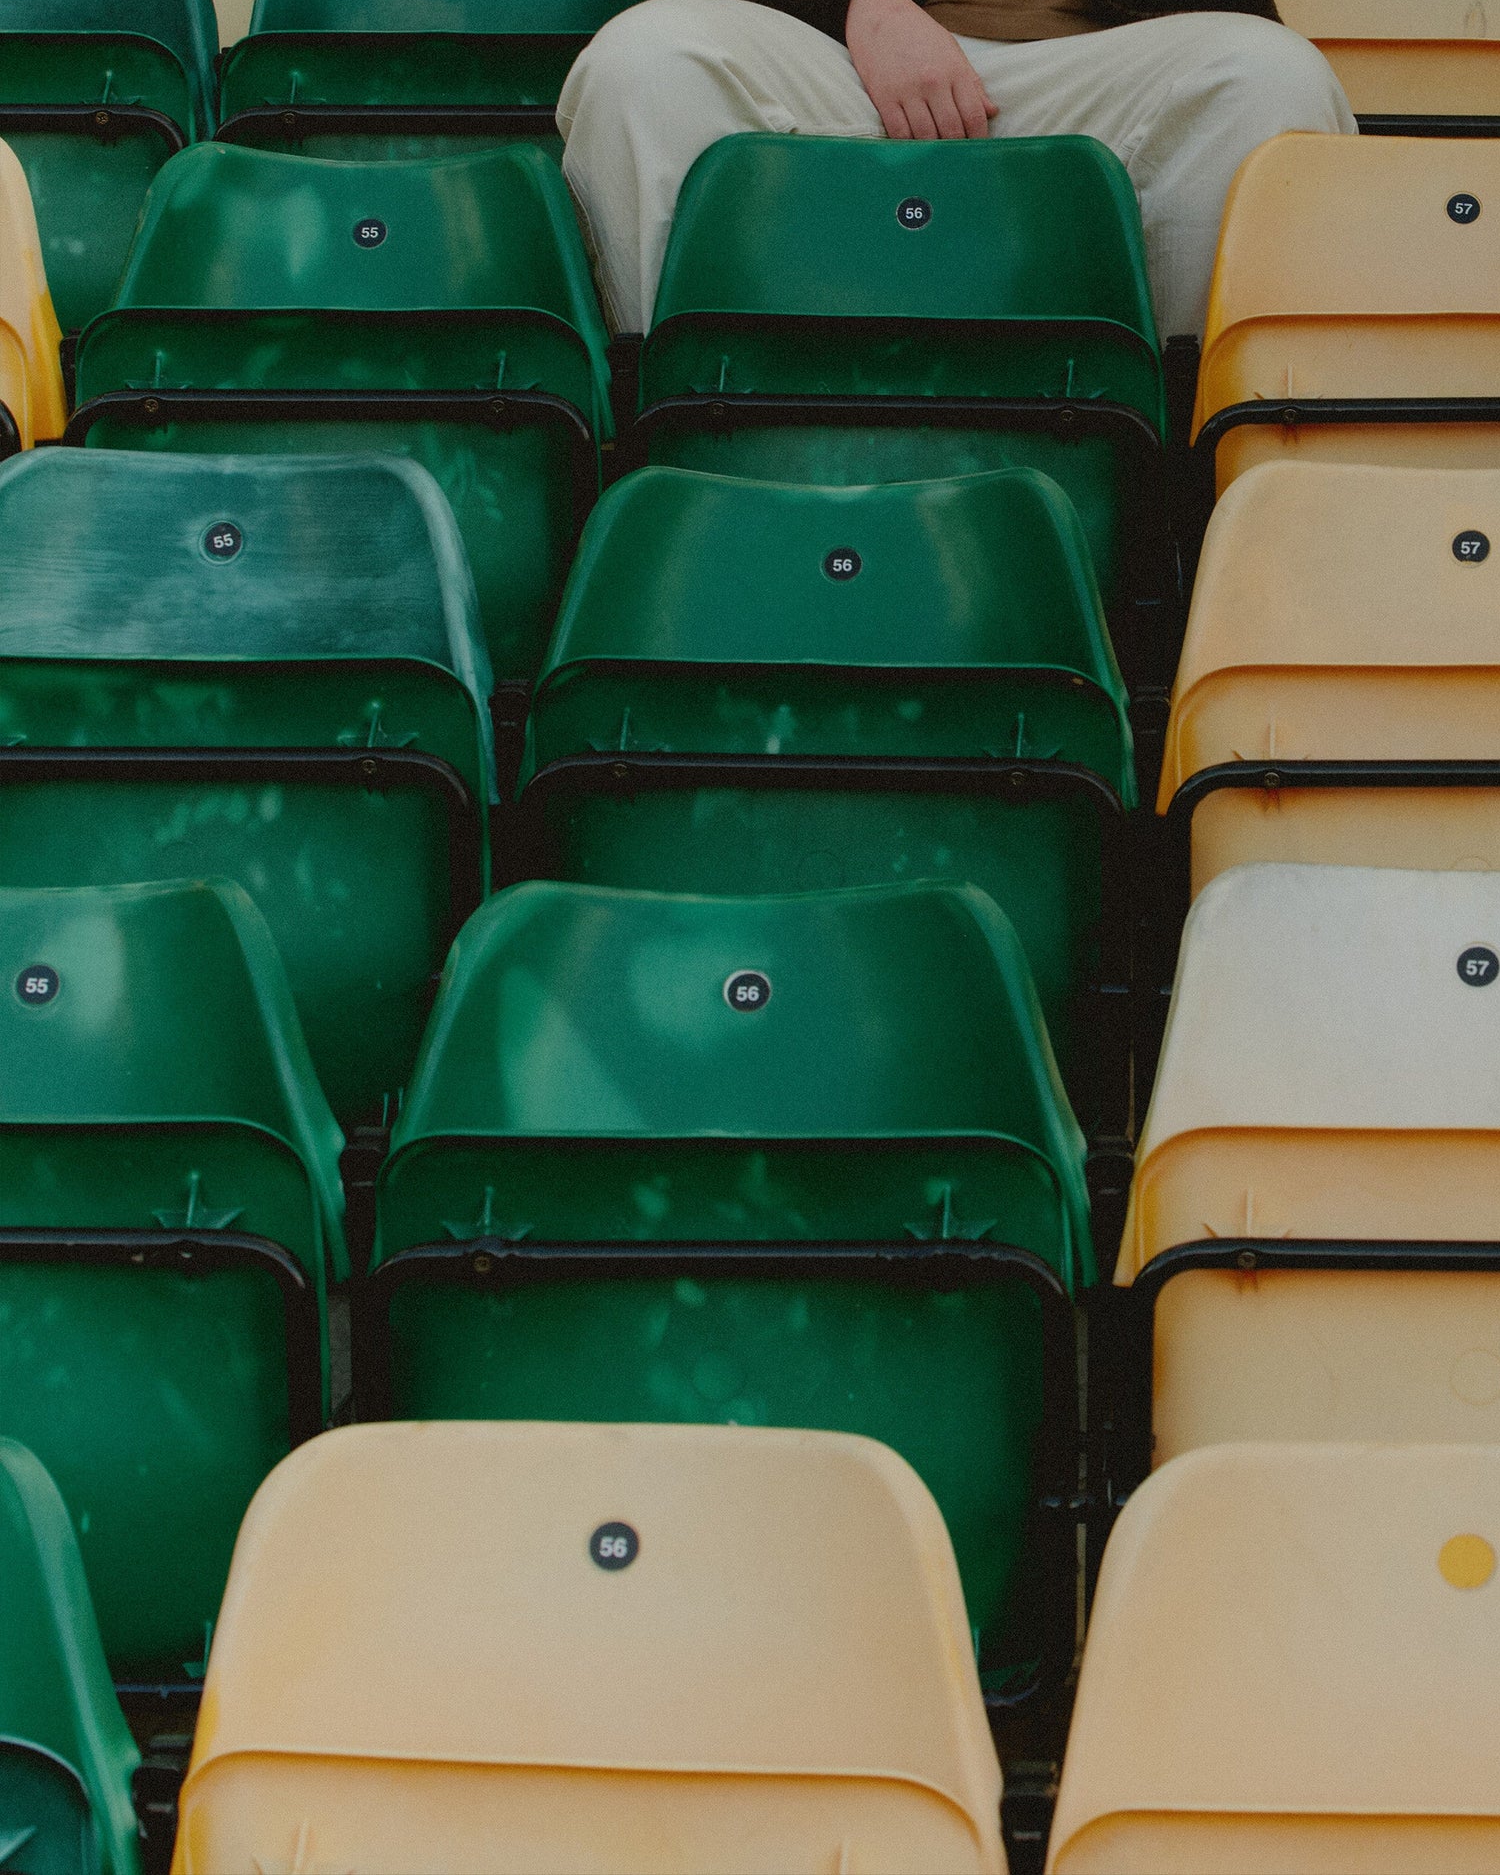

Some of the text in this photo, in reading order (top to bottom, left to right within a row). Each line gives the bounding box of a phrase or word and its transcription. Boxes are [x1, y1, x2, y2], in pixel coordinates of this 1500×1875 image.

[906, 207, 922, 219] 56
[1455, 203, 1473, 214] 57
[362, 227, 378, 238] 55
[214, 533, 233, 548] 55
[1461, 542, 1480, 554] 57
[833, 559, 852, 571] 56
[1466, 960, 1489, 976] 57
[26, 978, 48, 994] 55
[736, 986, 759, 1001] 56
[600, 1537, 627, 1558] 56
